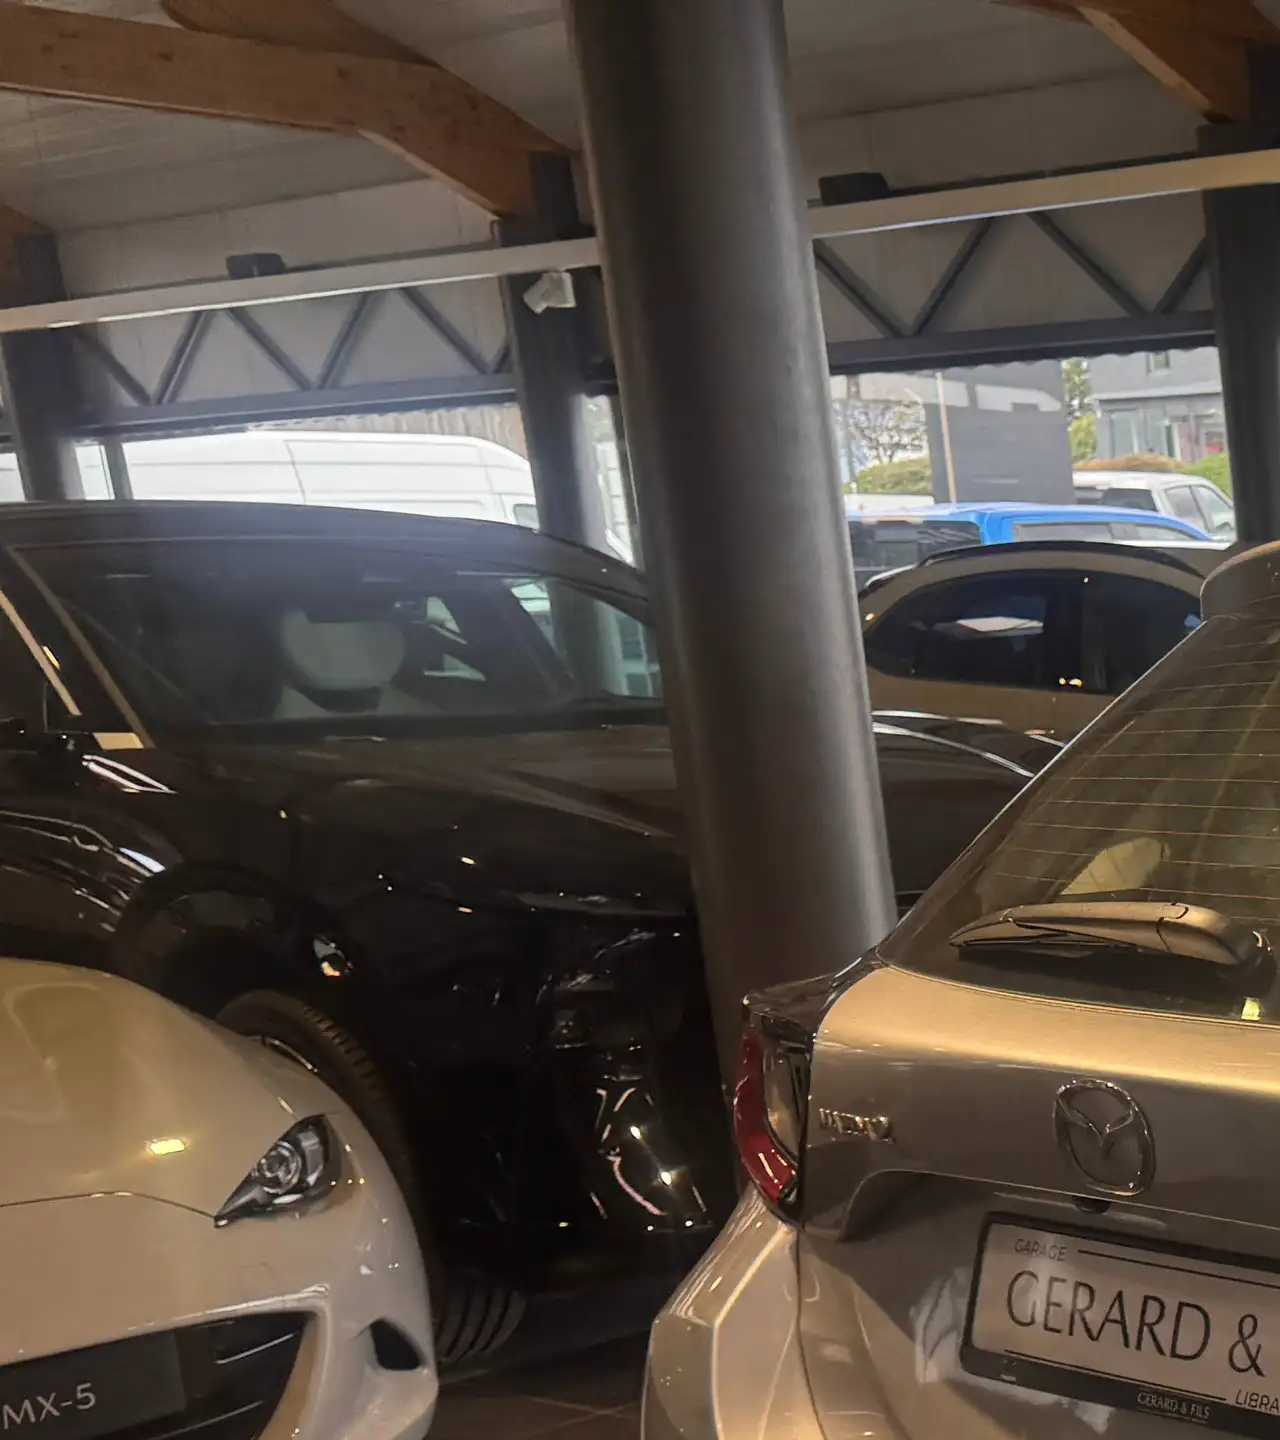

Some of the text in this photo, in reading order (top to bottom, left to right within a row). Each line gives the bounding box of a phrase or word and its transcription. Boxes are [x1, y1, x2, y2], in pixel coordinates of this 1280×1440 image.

[1015, 1238, 1069, 1261] GARAGE
[1007, 1269, 1211, 1361] GERARD
[1228, 1313, 1266, 1378] &
[2, 1382, 97, 1431] MX-5
